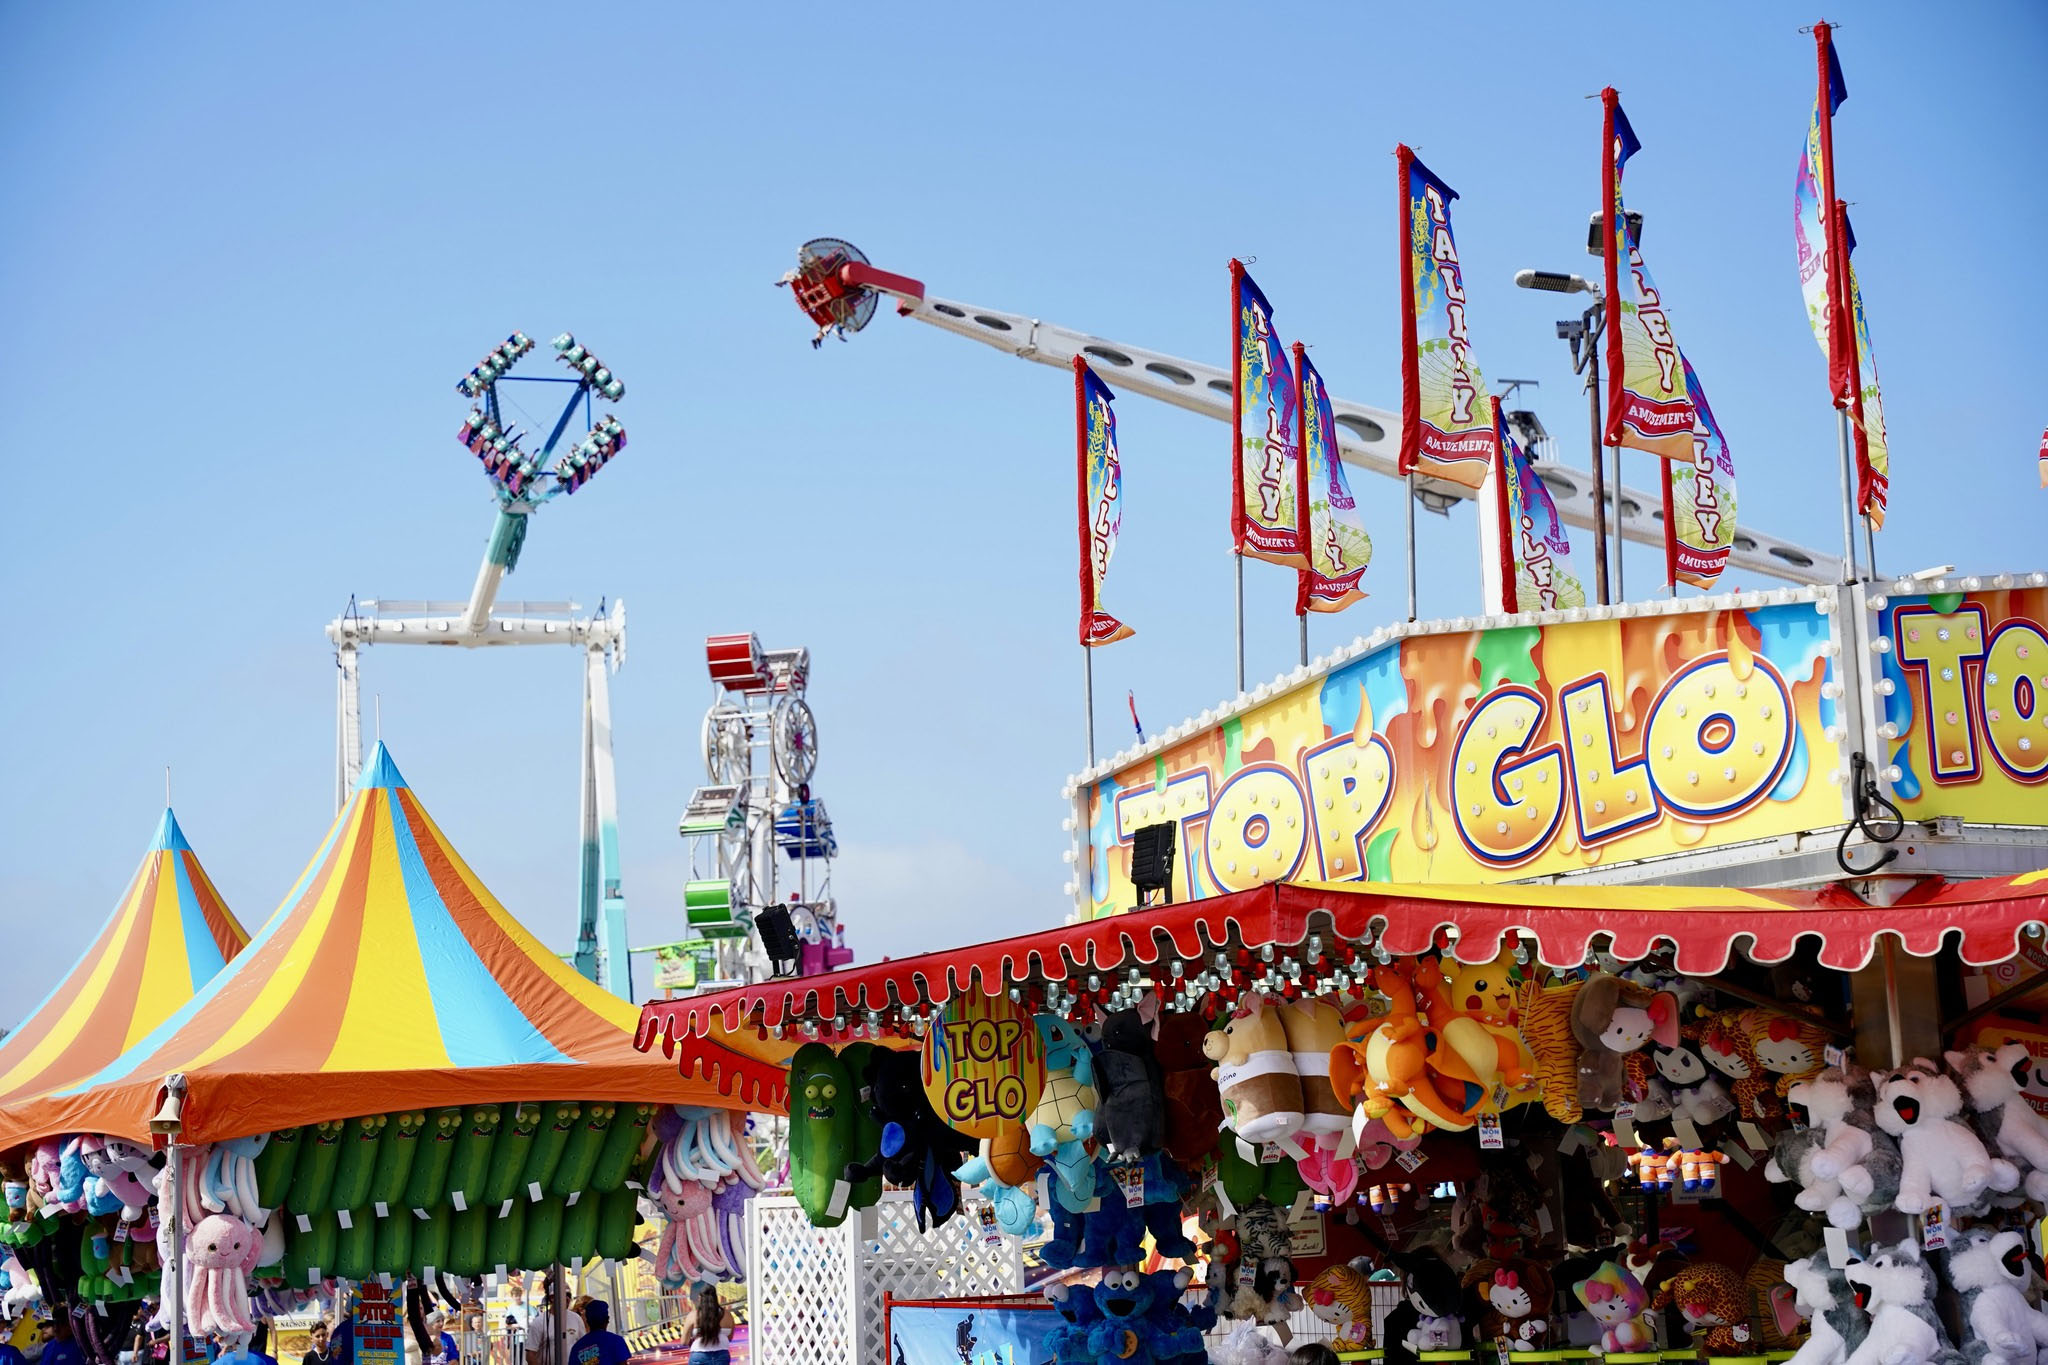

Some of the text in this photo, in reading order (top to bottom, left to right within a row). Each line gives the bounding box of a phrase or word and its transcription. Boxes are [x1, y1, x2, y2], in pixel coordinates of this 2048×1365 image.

[1252, 298, 1285, 522] TLEY
[1095, 390, 1120, 580] TALLE
[1114, 649, 1797, 902] TOP GLO
[1861, 880, 1871, 898] 4
[943, 1018, 1023, 1063] TOP
[944, 1074, 1027, 1122] GLO
[1128, 1186, 1142, 1194] WON
[983, 1225, 997, 1233] WON
[1926, 1225, 1942, 1234] WON
